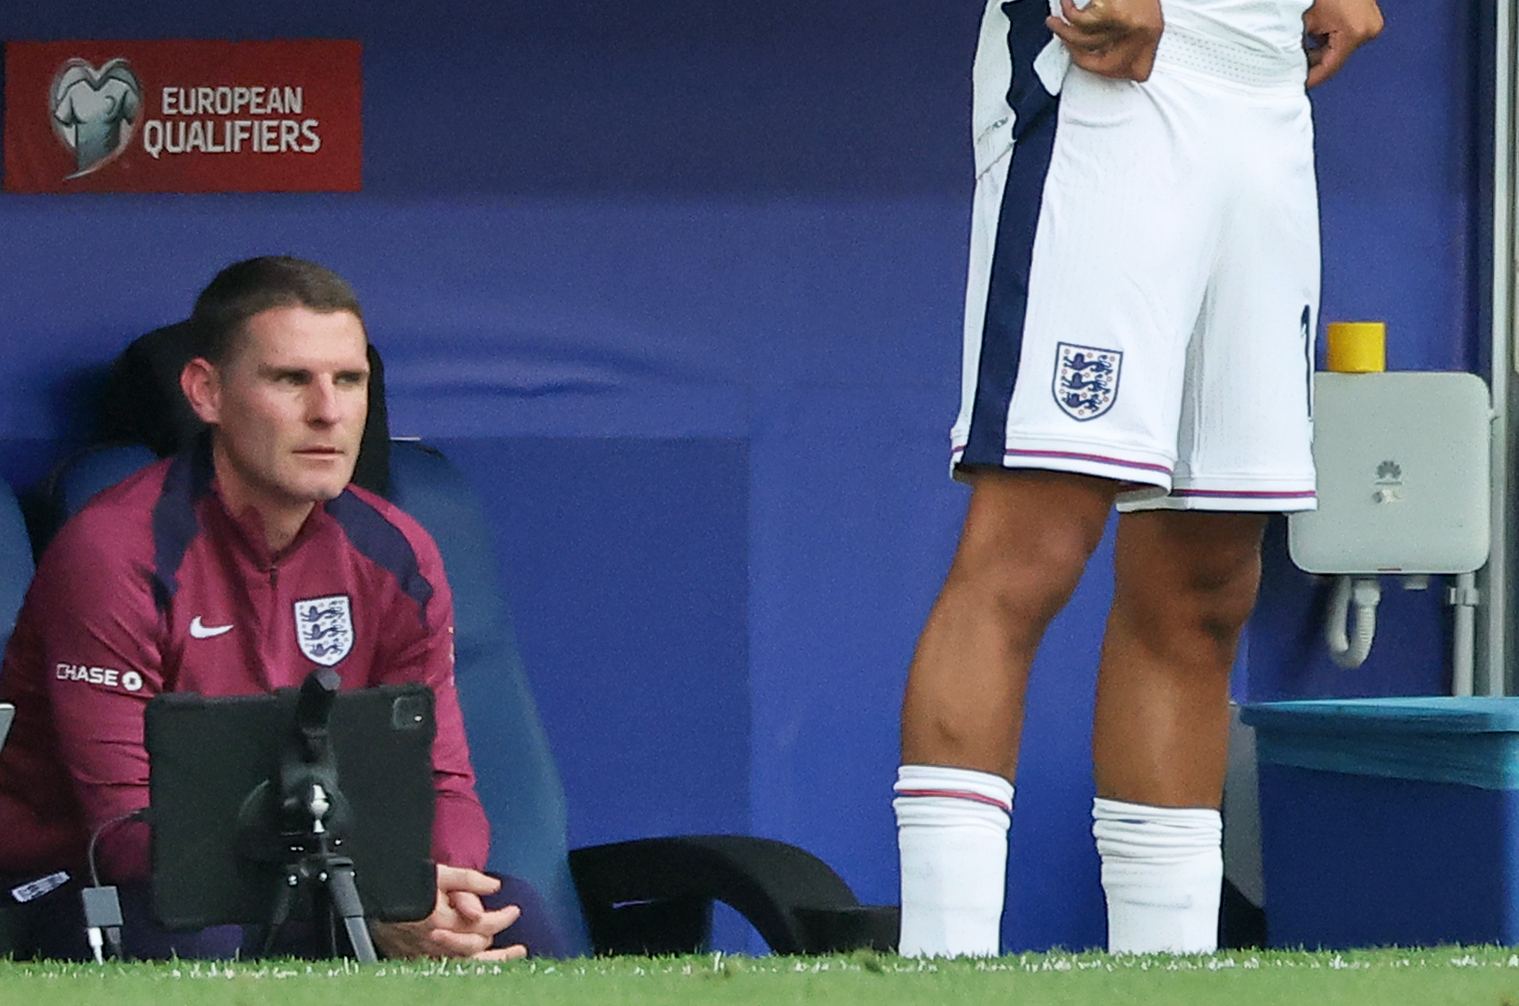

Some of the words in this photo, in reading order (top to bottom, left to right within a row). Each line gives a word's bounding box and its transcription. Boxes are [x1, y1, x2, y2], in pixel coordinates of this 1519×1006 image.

[162, 86, 303, 115] EUROPEAN
[143, 119, 321, 159] QUALIFIERS
[56, 663, 119, 686] CHASE
